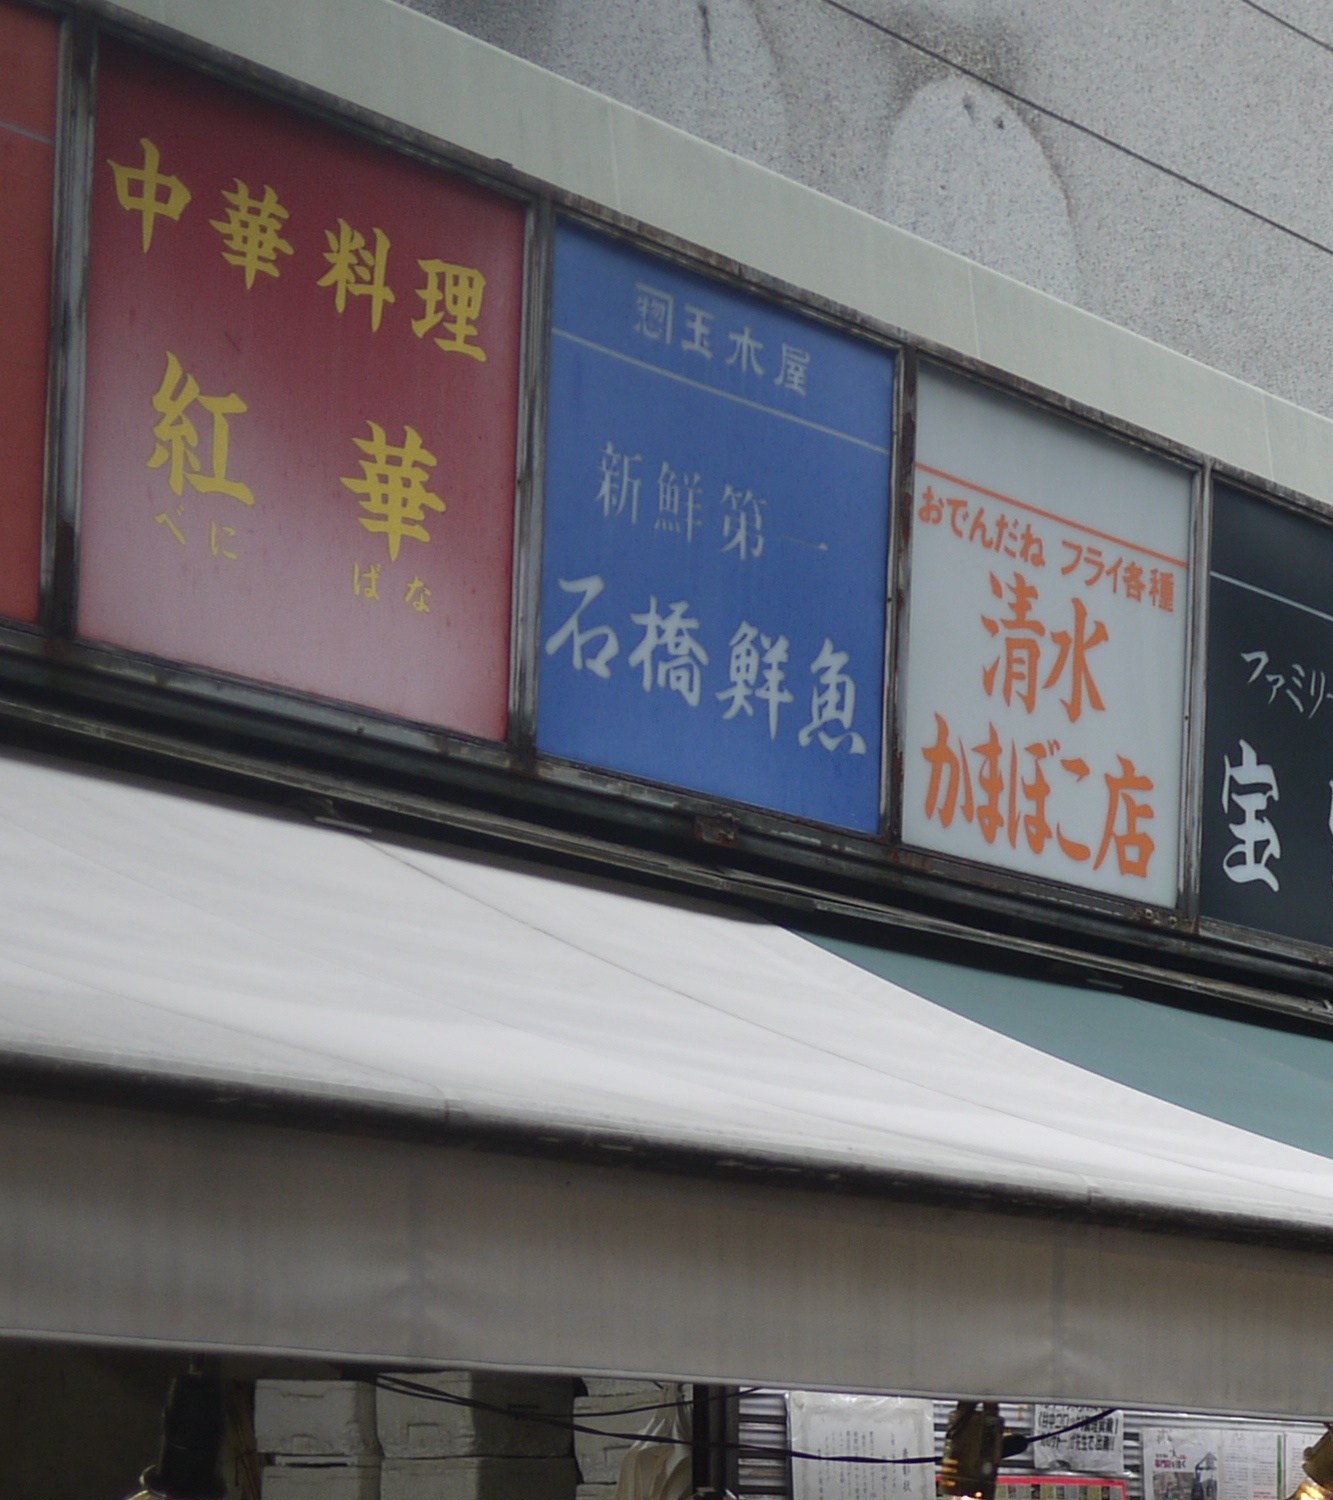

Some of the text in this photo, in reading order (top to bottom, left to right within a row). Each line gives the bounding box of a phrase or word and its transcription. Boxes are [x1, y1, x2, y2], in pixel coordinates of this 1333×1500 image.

[105, 137, 487, 364] 中華料理
[596, 441, 829, 562] 新鮮第一
[918, 485, 1176, 614] おでんだね フライ各種
[545, 575, 866, 757] 石橋鮮魚
[980, 569, 1110, 724] 清水
[921, 711, 1156, 880] かまぼこ店
